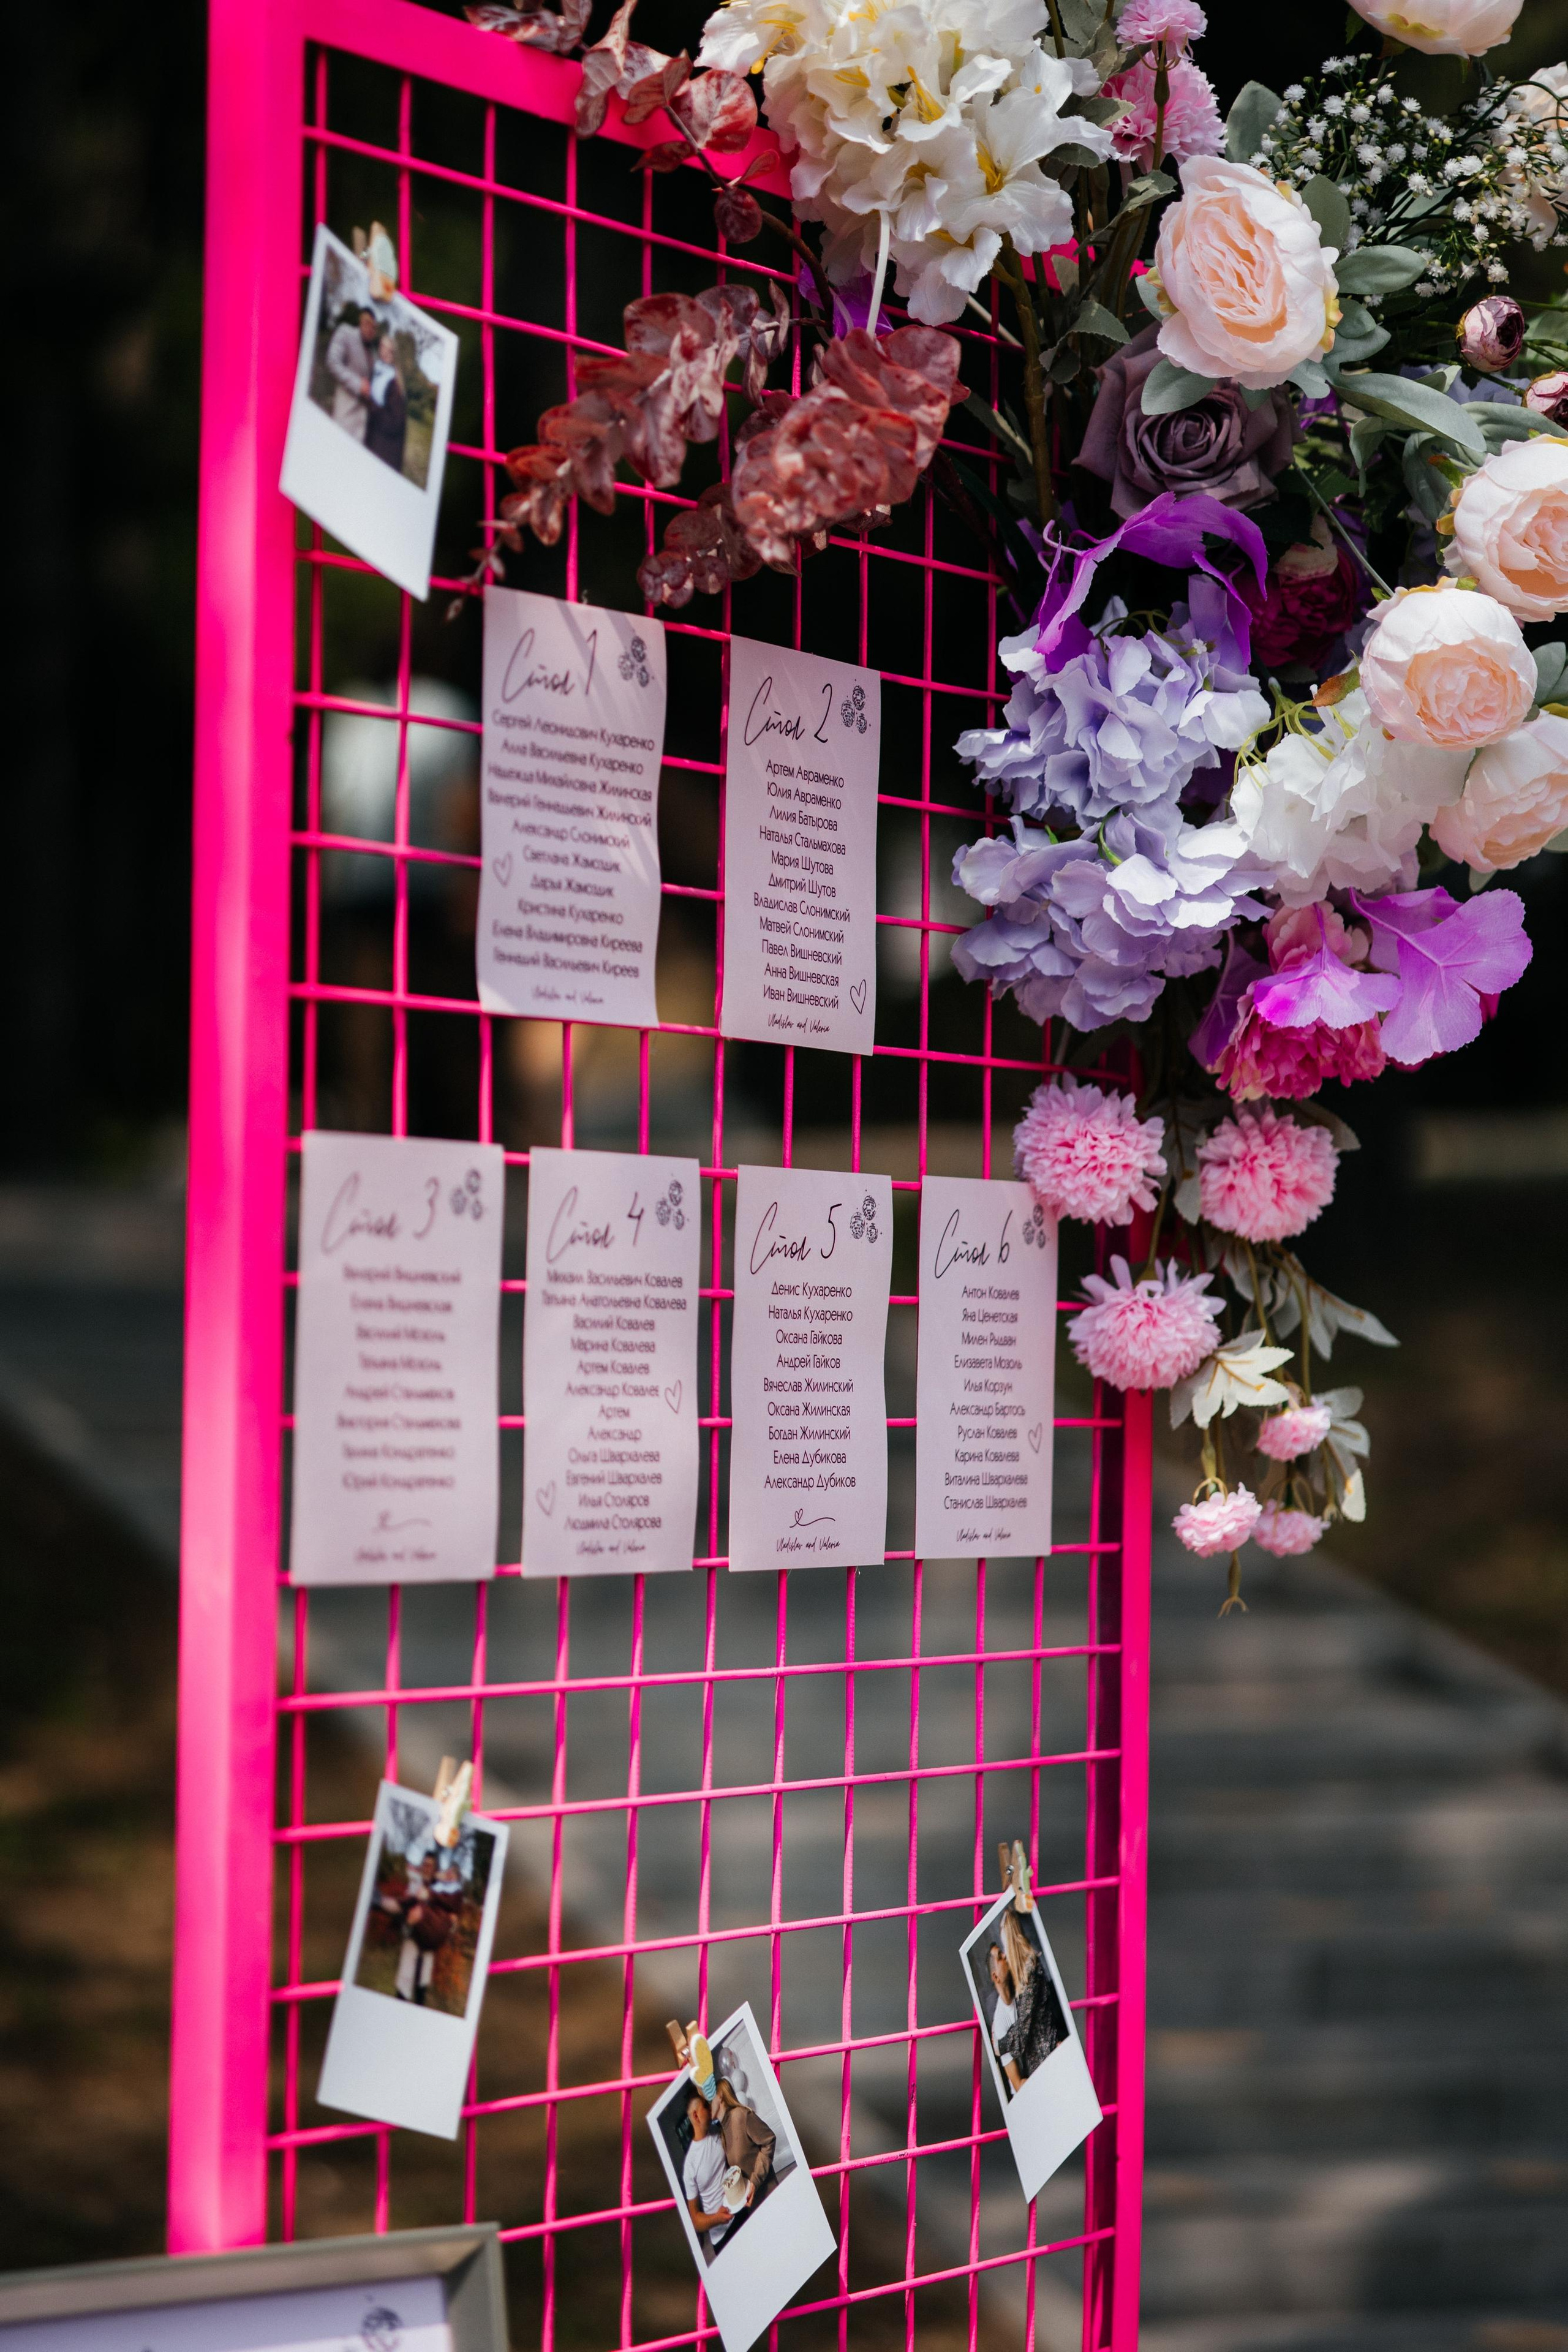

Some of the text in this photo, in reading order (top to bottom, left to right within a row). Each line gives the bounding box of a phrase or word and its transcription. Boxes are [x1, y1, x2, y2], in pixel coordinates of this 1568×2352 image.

[744, 676, 832, 745] Стол 2
[600, 728, 655, 751] Кухаренко
[589, 753, 643, 775] Кухаренко
[766, 760, 844, 788] Артем Авраменко
[767, 782, 842, 810] Юлия Авраменко
[769, 805, 837, 831] Лилия Батырова
[760, 826, 846, 855] Наталья Стальмахова
[772, 850, 833, 875] Мария Шутова
[768, 873, 836, 898] Дмитрий Шутов
[568, 905, 624, 925] Кухаренко
[754, 892, 850, 922] Владислав Слонимский
[760, 916, 843, 943] Матвей Слонимский
[762, 939, 842, 965] Павел Вишневский
[764, 963, 839, 986] Анна Вишневская
[763, 984, 839, 1009] Иван Вишневский
[797, 1018, 807, 1033] and
[750, 1202, 842, 1275] Стол 5
[935, 1209, 1012, 1278] Стол 6
[645, 1273, 683, 1288] Ковалев
[771, 1281, 852, 1300] Денис Кухаренко
[962, 1286, 1019, 1300] Антон Ковалев
[644, 1295, 687, 1310] Ковалева
[769, 1305, 853, 1324] Наталья Кухаренко
[962, 1308, 976, 1322] Яна
[616, 1316, 655, 1331] Ковалев
[776, 1329, 842, 1344] Оксана Гайкова
[611, 1338, 655, 1353] Ковалева
[611, 1360, 650, 1374] Ковалев
[777, 1354, 840, 1371] Андрей Гайков
[954, 1354, 992, 1369] Елизавета
[764, 1378, 853, 1392] Вячеслав Жилинский
[964, 1379, 1012, 1395] Илья Корзун
[767, 1401, 850, 1416] Оксана Жилинская
[950, 1402, 993, 1417] Александр
[769, 1426, 850, 1440] Богдан Жилинский
[958, 1425, 1017, 1442] Руслан Ковалев
[774, 1449, 846, 1467] Елена Дубикова
[955, 1449, 1019, 1464] Карина Ковалева
[764, 1472, 856, 1491] Александр Дубиков
[945, 1472, 1028, 1487] Виталина Швархалева
[944, 1496, 1027, 1510] Станислав Швархалев
[805, 1537, 816, 1551] and
